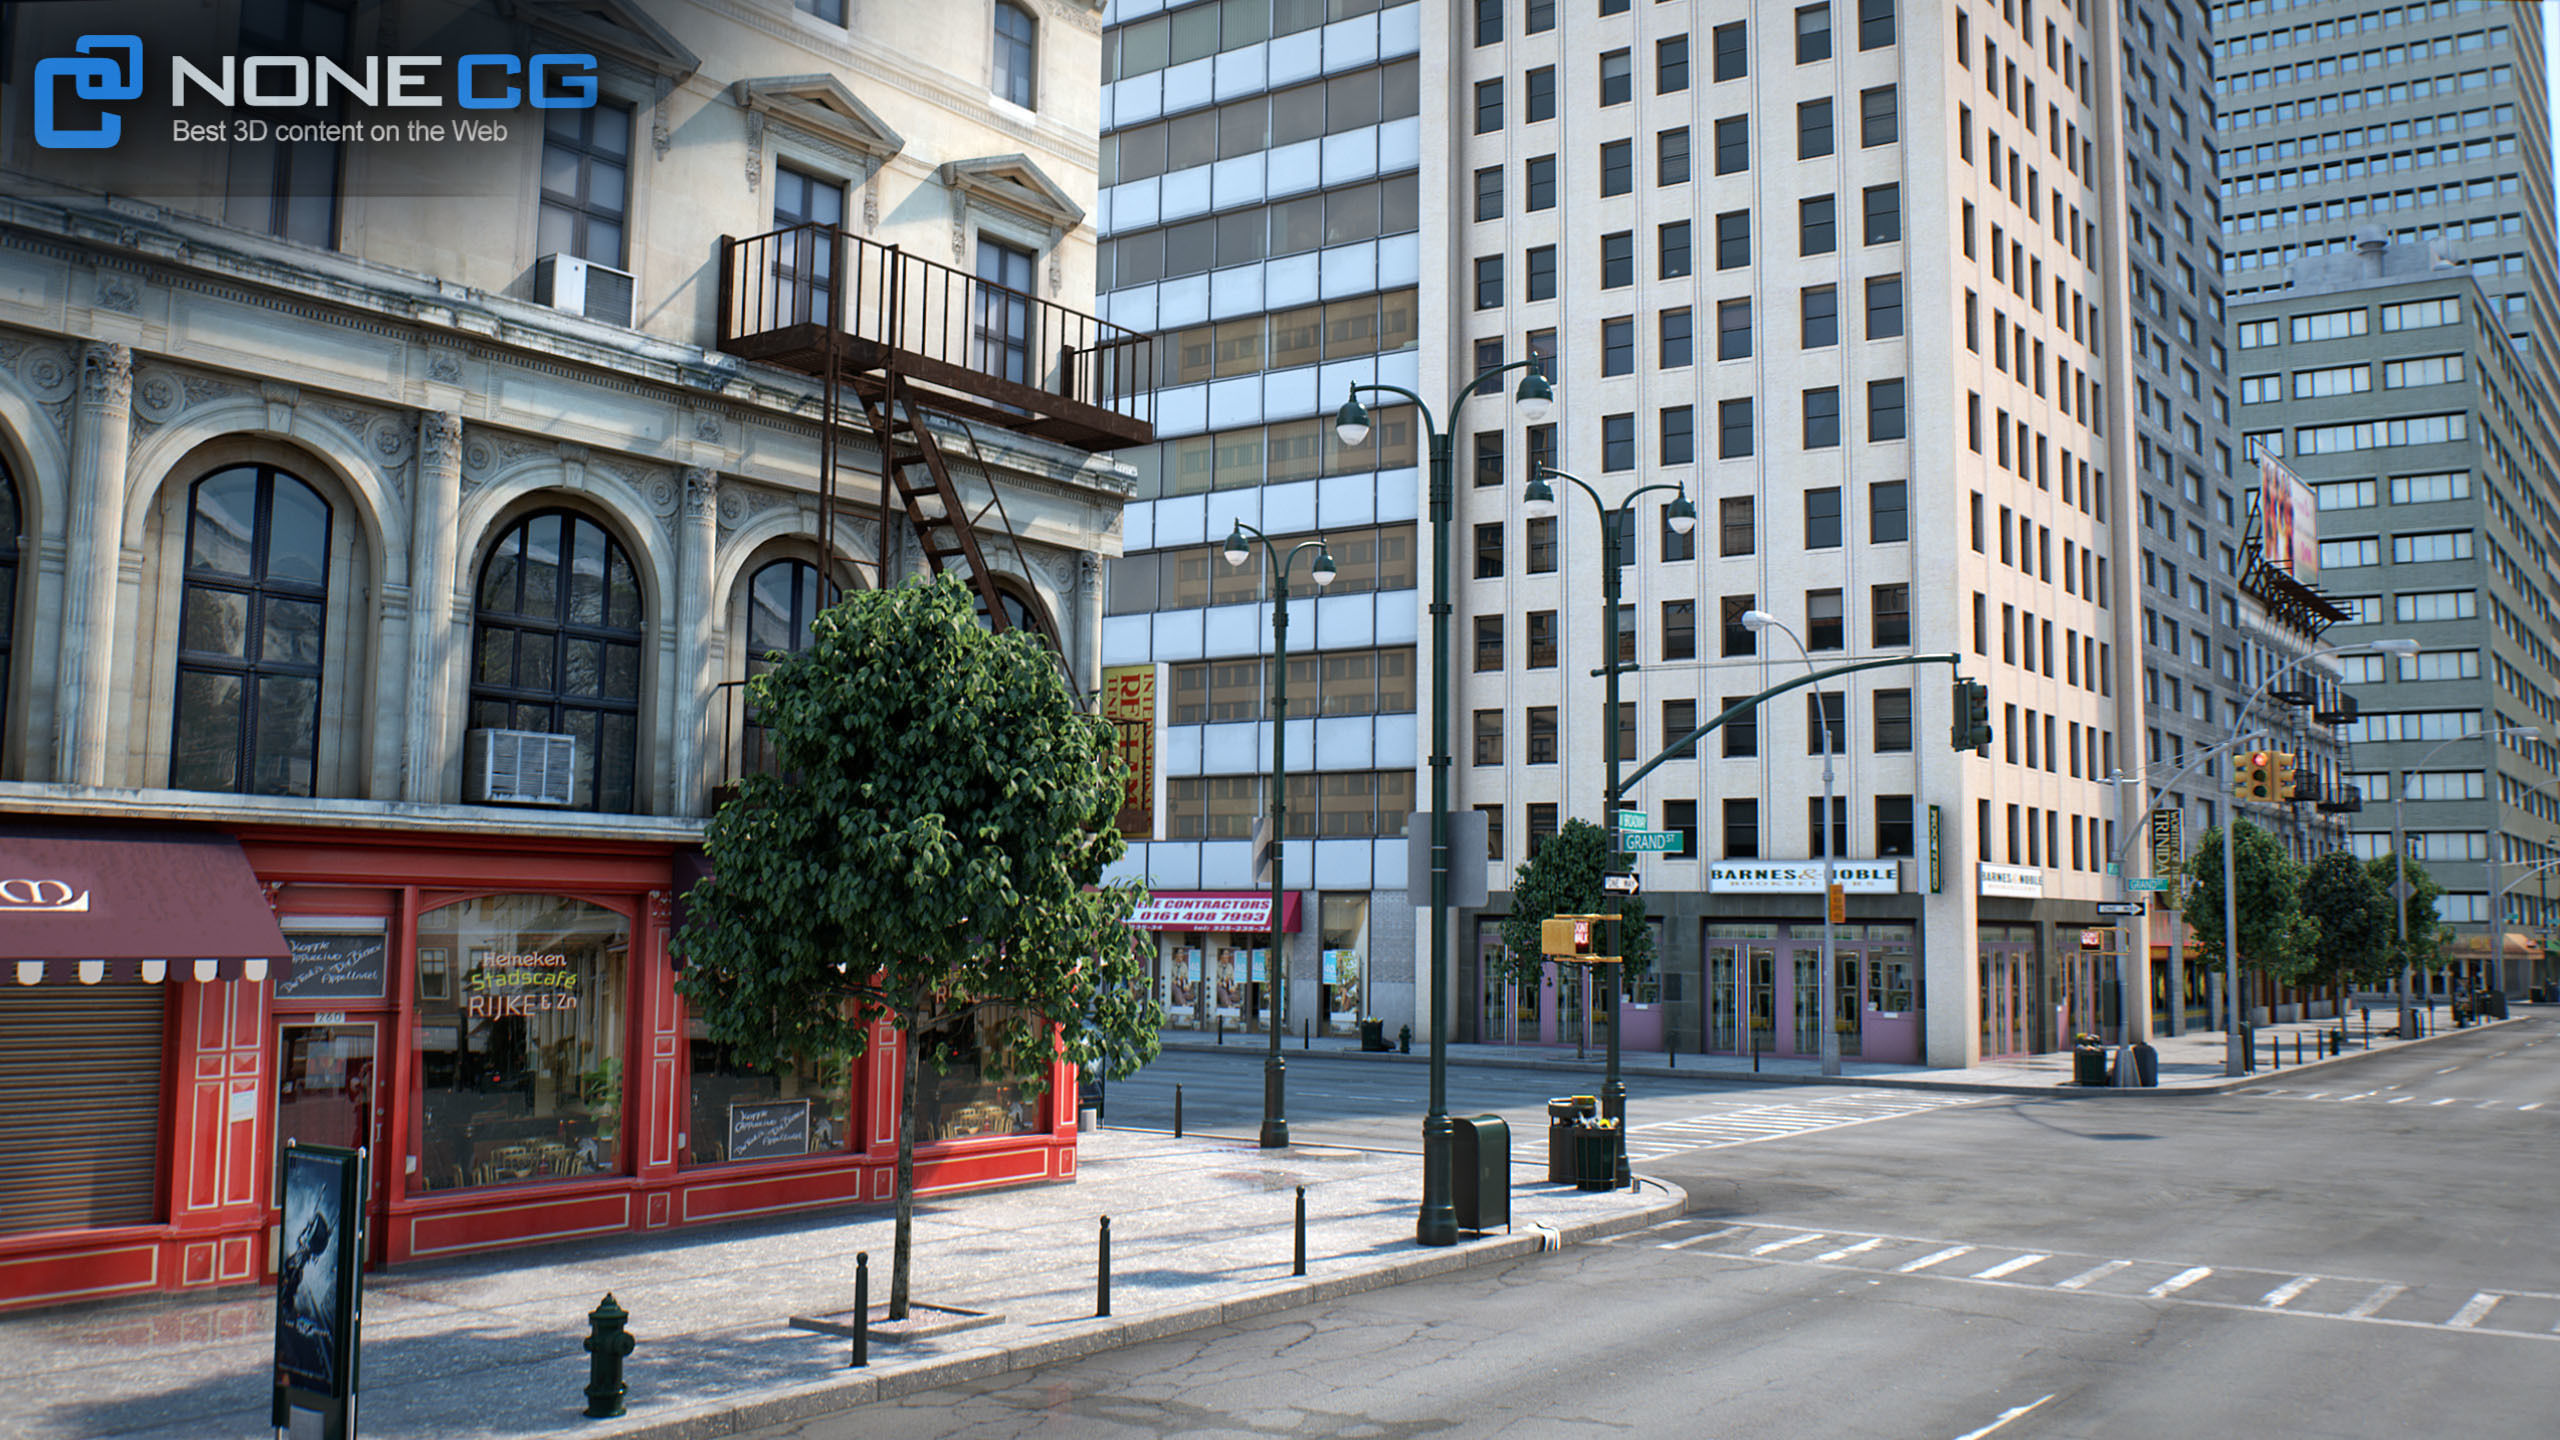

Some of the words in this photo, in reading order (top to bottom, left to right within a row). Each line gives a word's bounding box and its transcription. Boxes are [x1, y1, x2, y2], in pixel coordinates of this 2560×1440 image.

[1626, 834, 1665, 850] GRAND
[1666, 834, 1675, 843] ST
[1711, 869, 1796, 880] BARNES
[1163, 900, 1270, 909] CONTRACTORS
[1140, 911, 1180, 920] 0161
[1182, 911, 1217, 920] 408
[1221, 912, 1266, 921] 7993
[483, 952, 567, 967] Heineken
[471, 969, 577, 991] Stadscafé
[468, 995, 538, 1021] RIJKE
